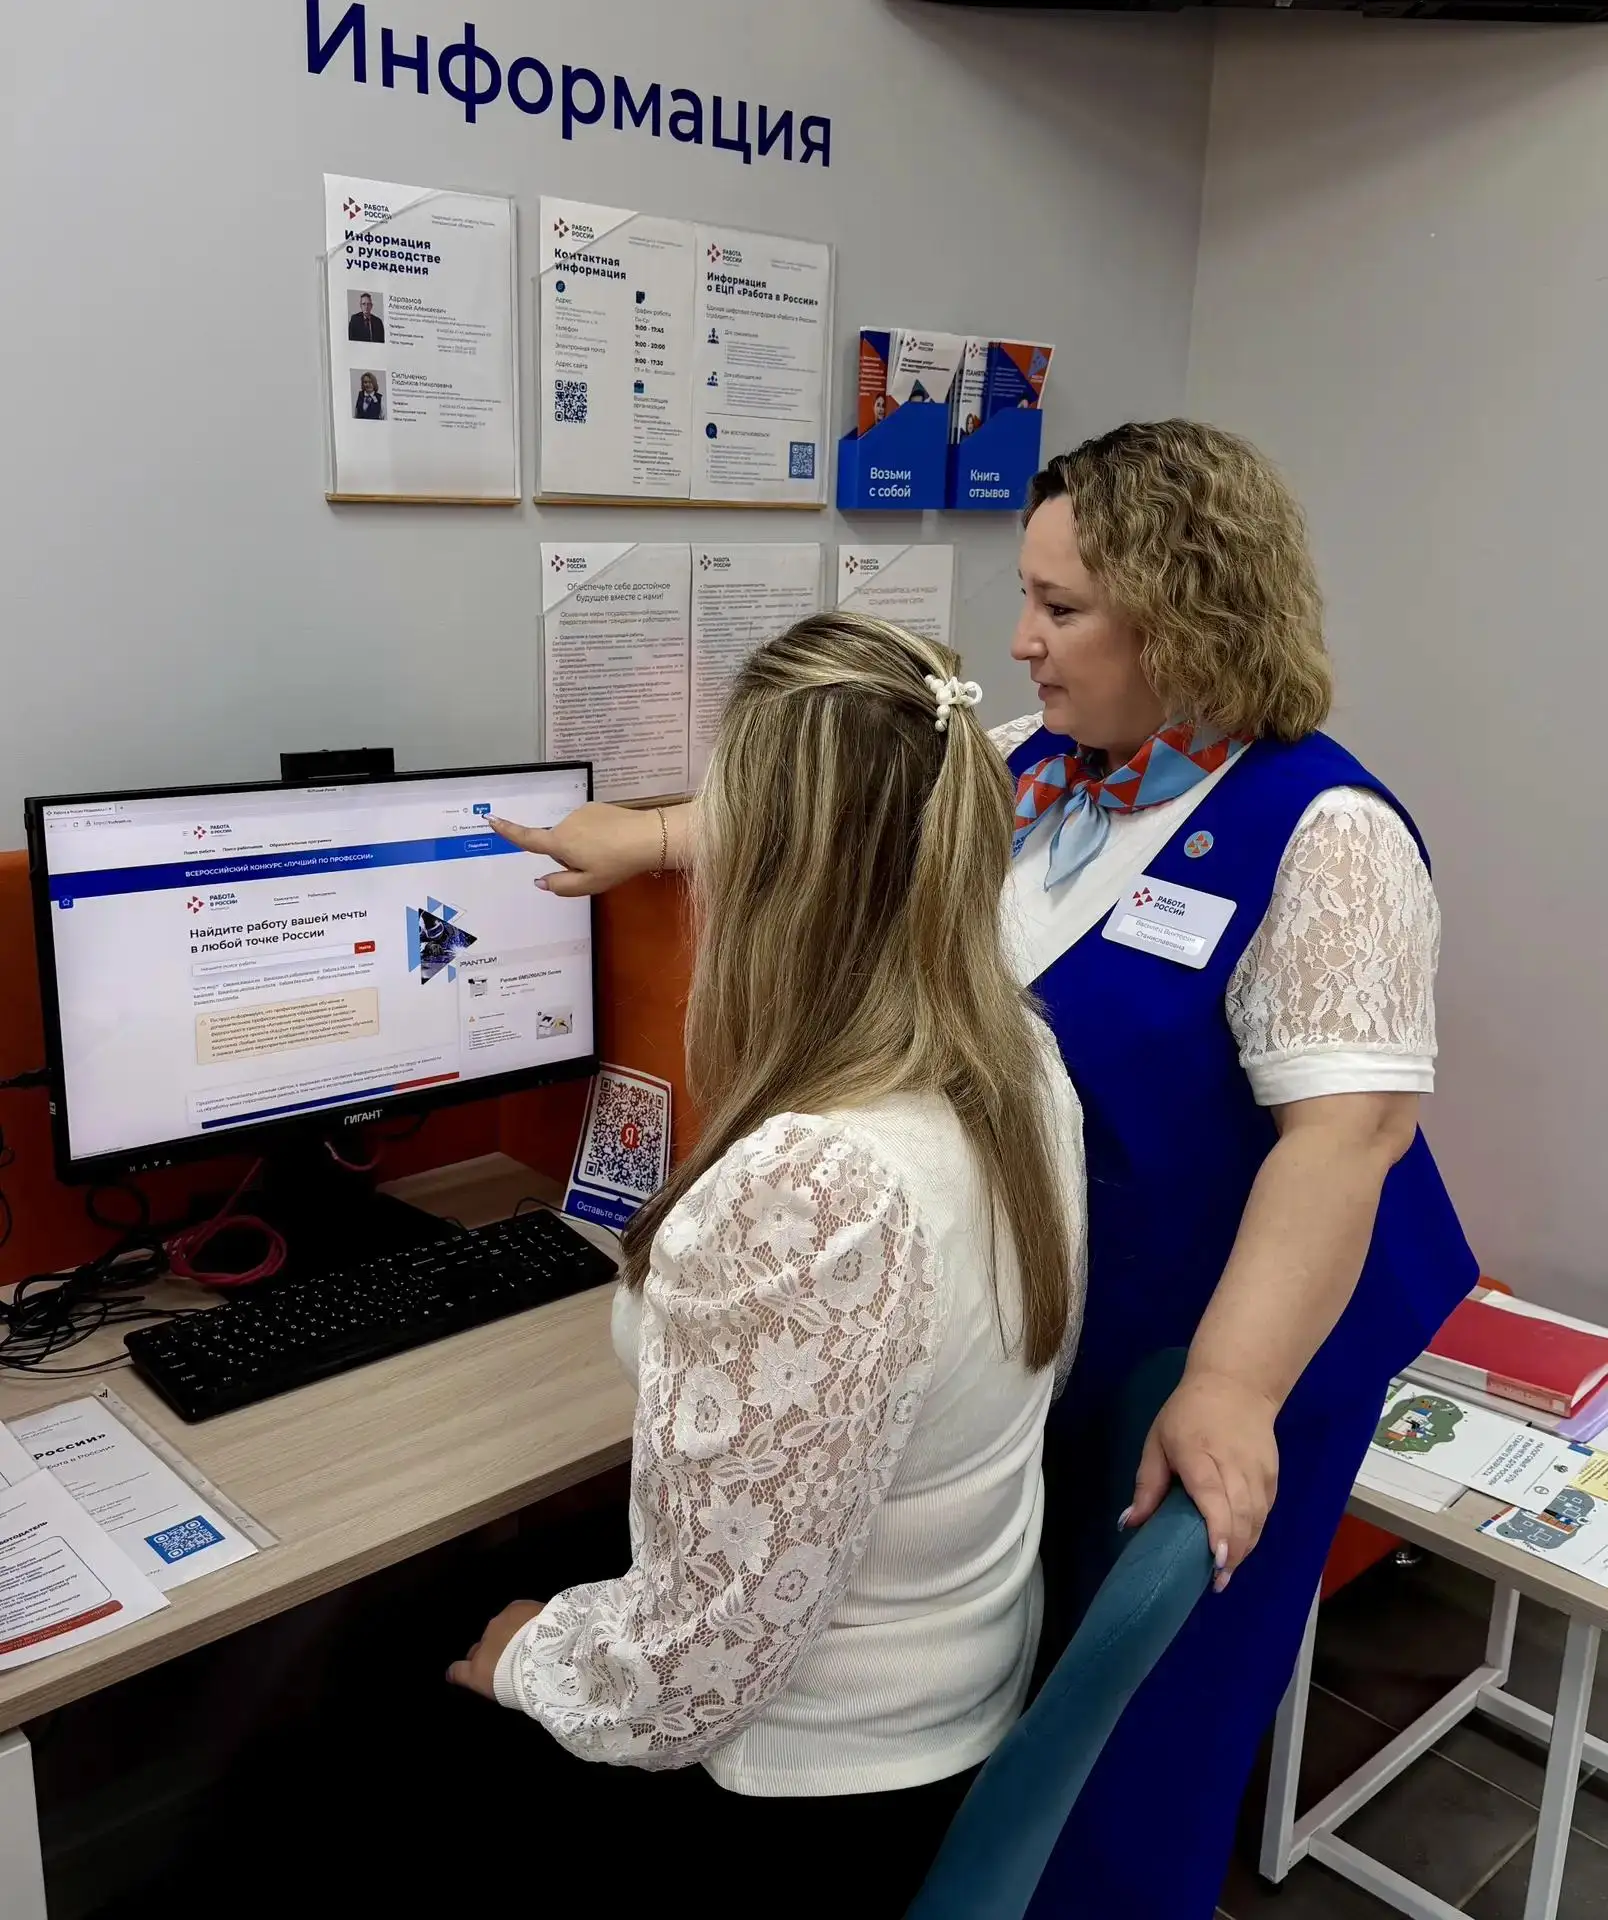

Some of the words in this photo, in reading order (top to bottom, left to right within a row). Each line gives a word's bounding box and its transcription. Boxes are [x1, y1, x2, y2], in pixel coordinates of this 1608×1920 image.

[305, 0, 831, 167] Информация
[364, 203, 389, 212] РАБОТА
[364, 211, 392, 220] РОССИИ
[572, 224, 593, 232] РАБОТА
[572, 231, 594, 239] РОССИИ
[345, 230, 431, 249] Информация
[359, 248, 441, 264] руководстве
[555, 248, 620, 266] Контактная
[346, 258, 429, 275] учреждения
[555, 263, 626, 280] информация
[707, 272, 766, 288] Информация
[716, 285, 734, 295] ЕЦП
[737, 288, 773, 301] «Работа
[783, 294, 818, 306] России»
[870, 467, 911, 480] Возьми
[970, 469, 1000, 482] Книга
[869, 488, 875, 496] с
[878, 485, 911, 498] собой
[969, 488, 1010, 499] отзывов
[567, 583, 613, 591] Обеспечьте
[633, 582, 671, 590] достойное
[576, 594, 608, 603] будущее
[185, 864, 248, 878] ВСЕРОССИЙСКИЙ
[250, 861, 282, 871] КОНКУРС
[284, 858, 317, 868] «ЛУЧШИЙ
[330, 852, 374, 863] ПРОФЕССИИ»
[209, 893, 235, 901] РАБОТА
[1158, 896, 1186, 909] РАБОТА
[1154, 902, 1185, 916] РОССИИ
[190, 924, 243, 939] Найдите
[247, 918, 288, 934] работу
[292, 912, 328, 925] вашей
[332, 909, 367, 922] мечты
[191, 945, 198, 954] в
[201, 938, 242, 953] любой
[246, 935, 279, 947] точке
[282, 929, 325, 942] России
[460, 957, 497, 967] PANTUM
[344, 1109, 381, 1125] ГИГАНТ
[625, 1128, 634, 1145] Я
[576, 1200, 613, 1218] Оставьте
[614, 1211, 629, 1222] сво
[33, 1433, 106, 1460] России»
